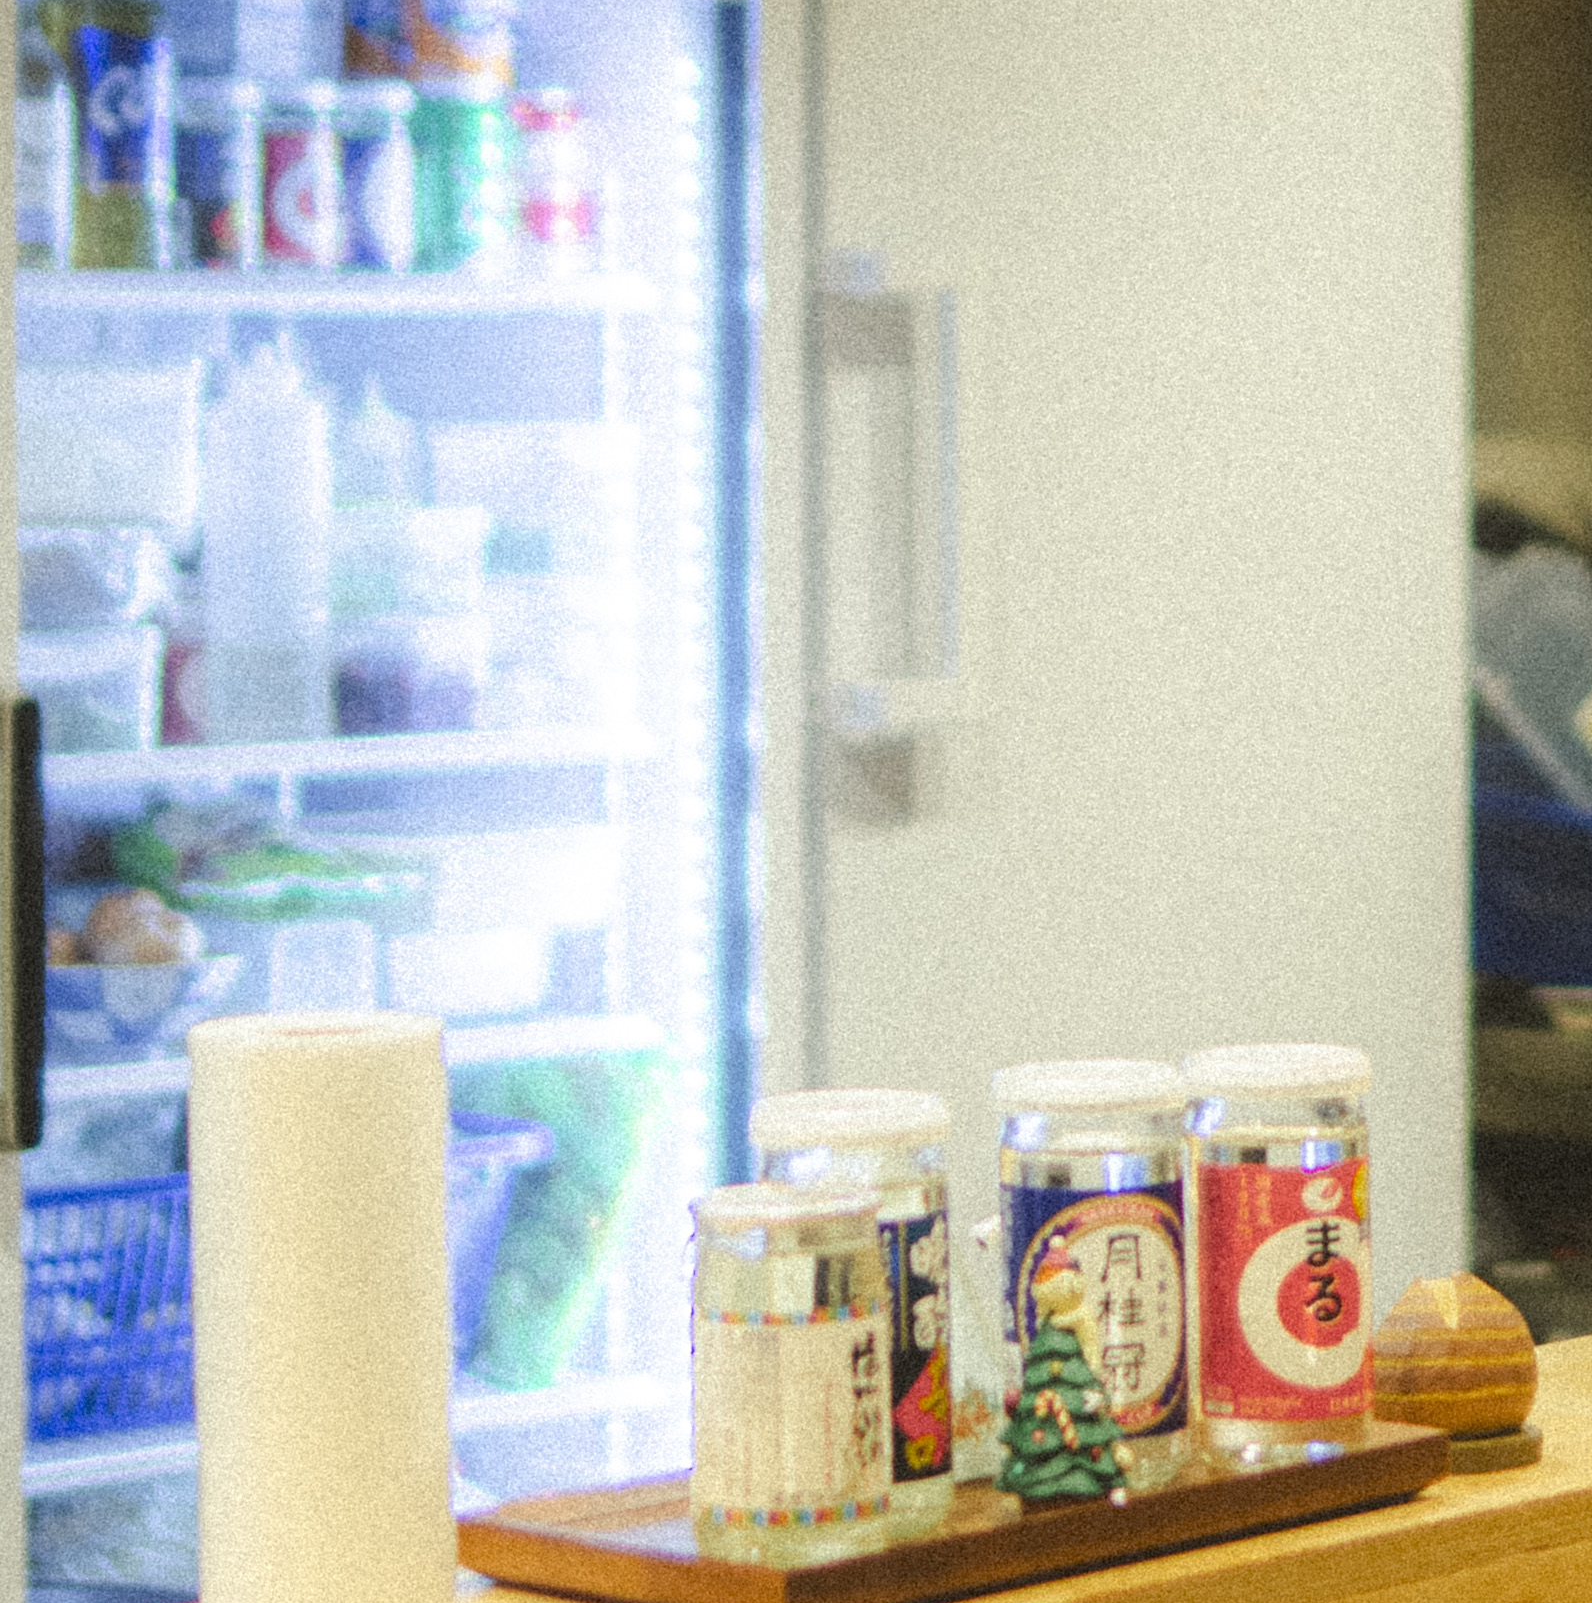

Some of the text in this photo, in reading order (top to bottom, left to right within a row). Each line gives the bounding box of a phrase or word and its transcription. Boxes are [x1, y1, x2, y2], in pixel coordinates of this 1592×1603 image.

[1098, 1234, 1148, 1394] 月桂冠
[1305, 1220, 1343, 1322] まる
